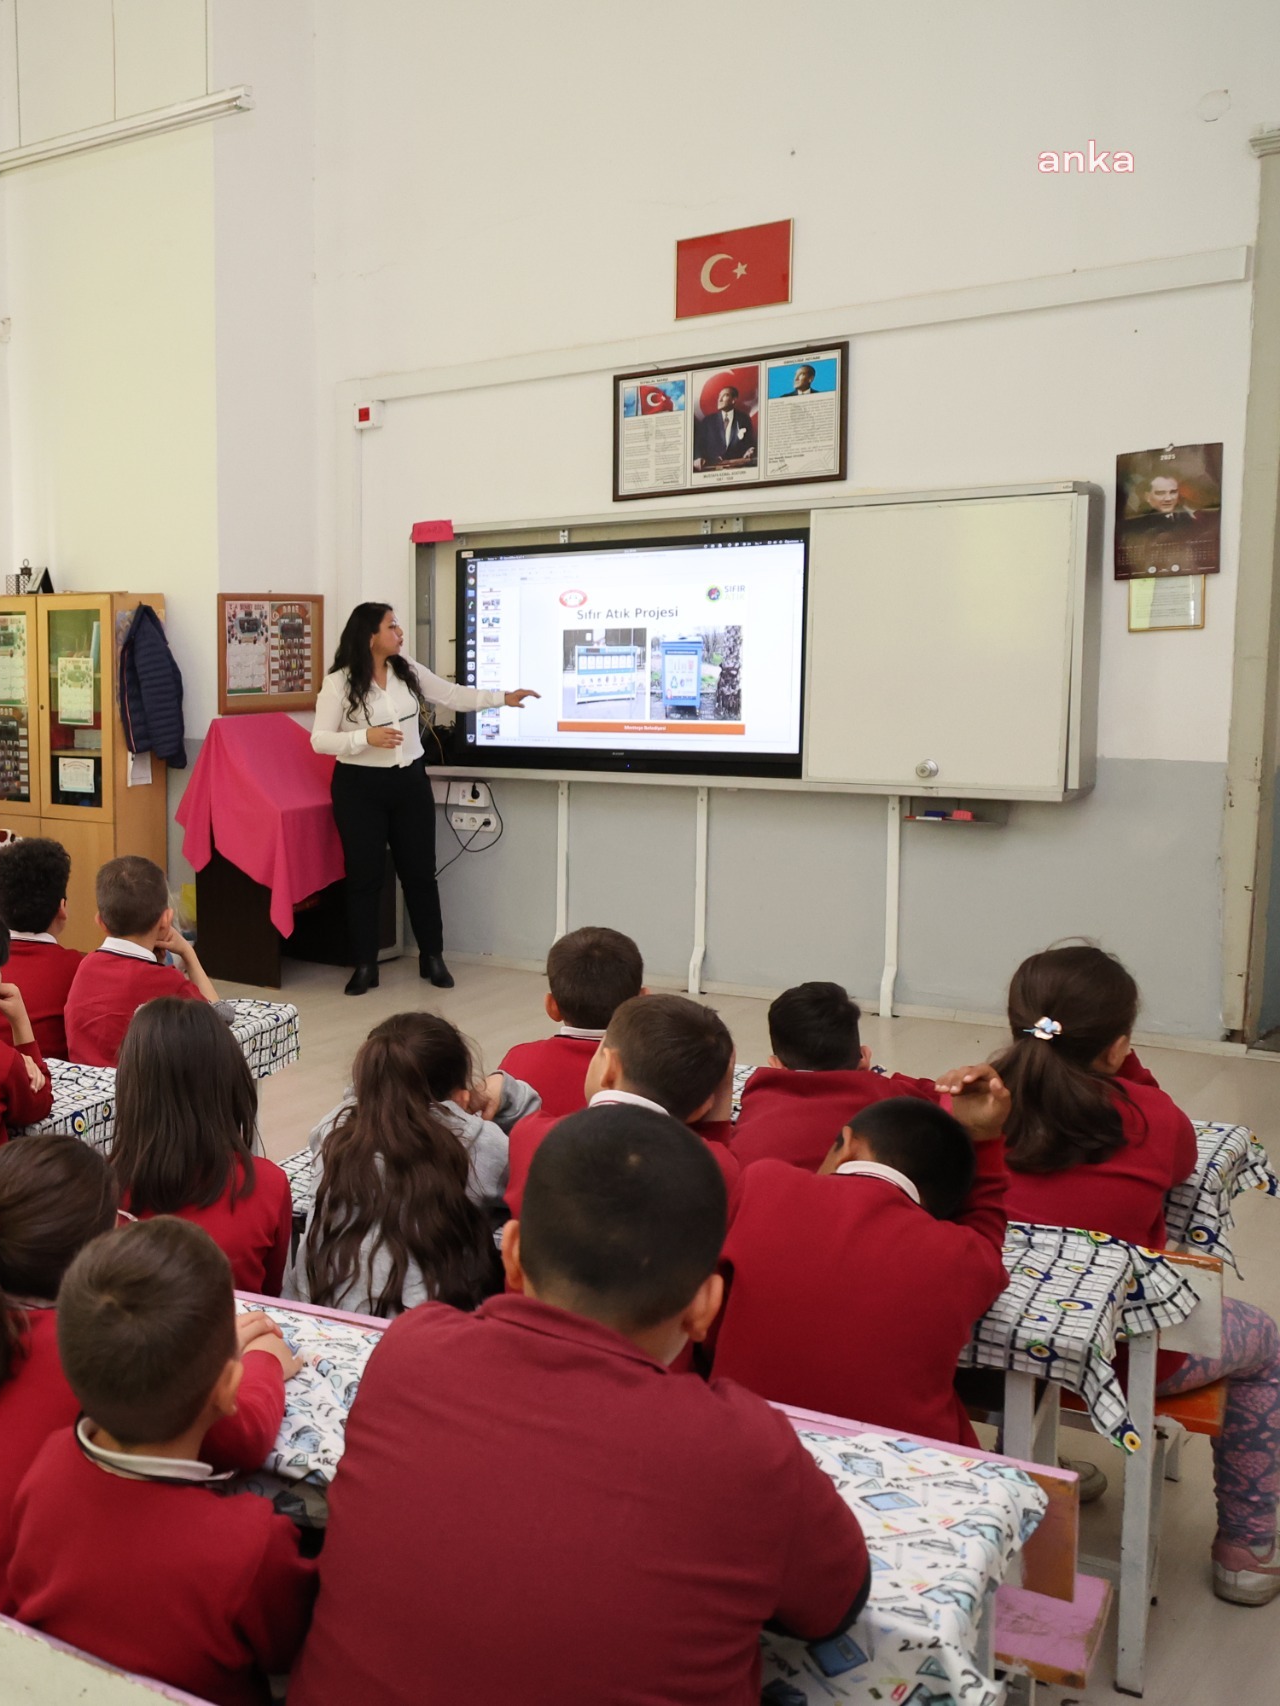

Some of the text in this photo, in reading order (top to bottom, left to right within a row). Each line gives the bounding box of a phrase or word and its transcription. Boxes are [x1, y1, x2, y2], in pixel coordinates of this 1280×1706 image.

[577, 606, 679, 620] Sıfır Atık Projesi
